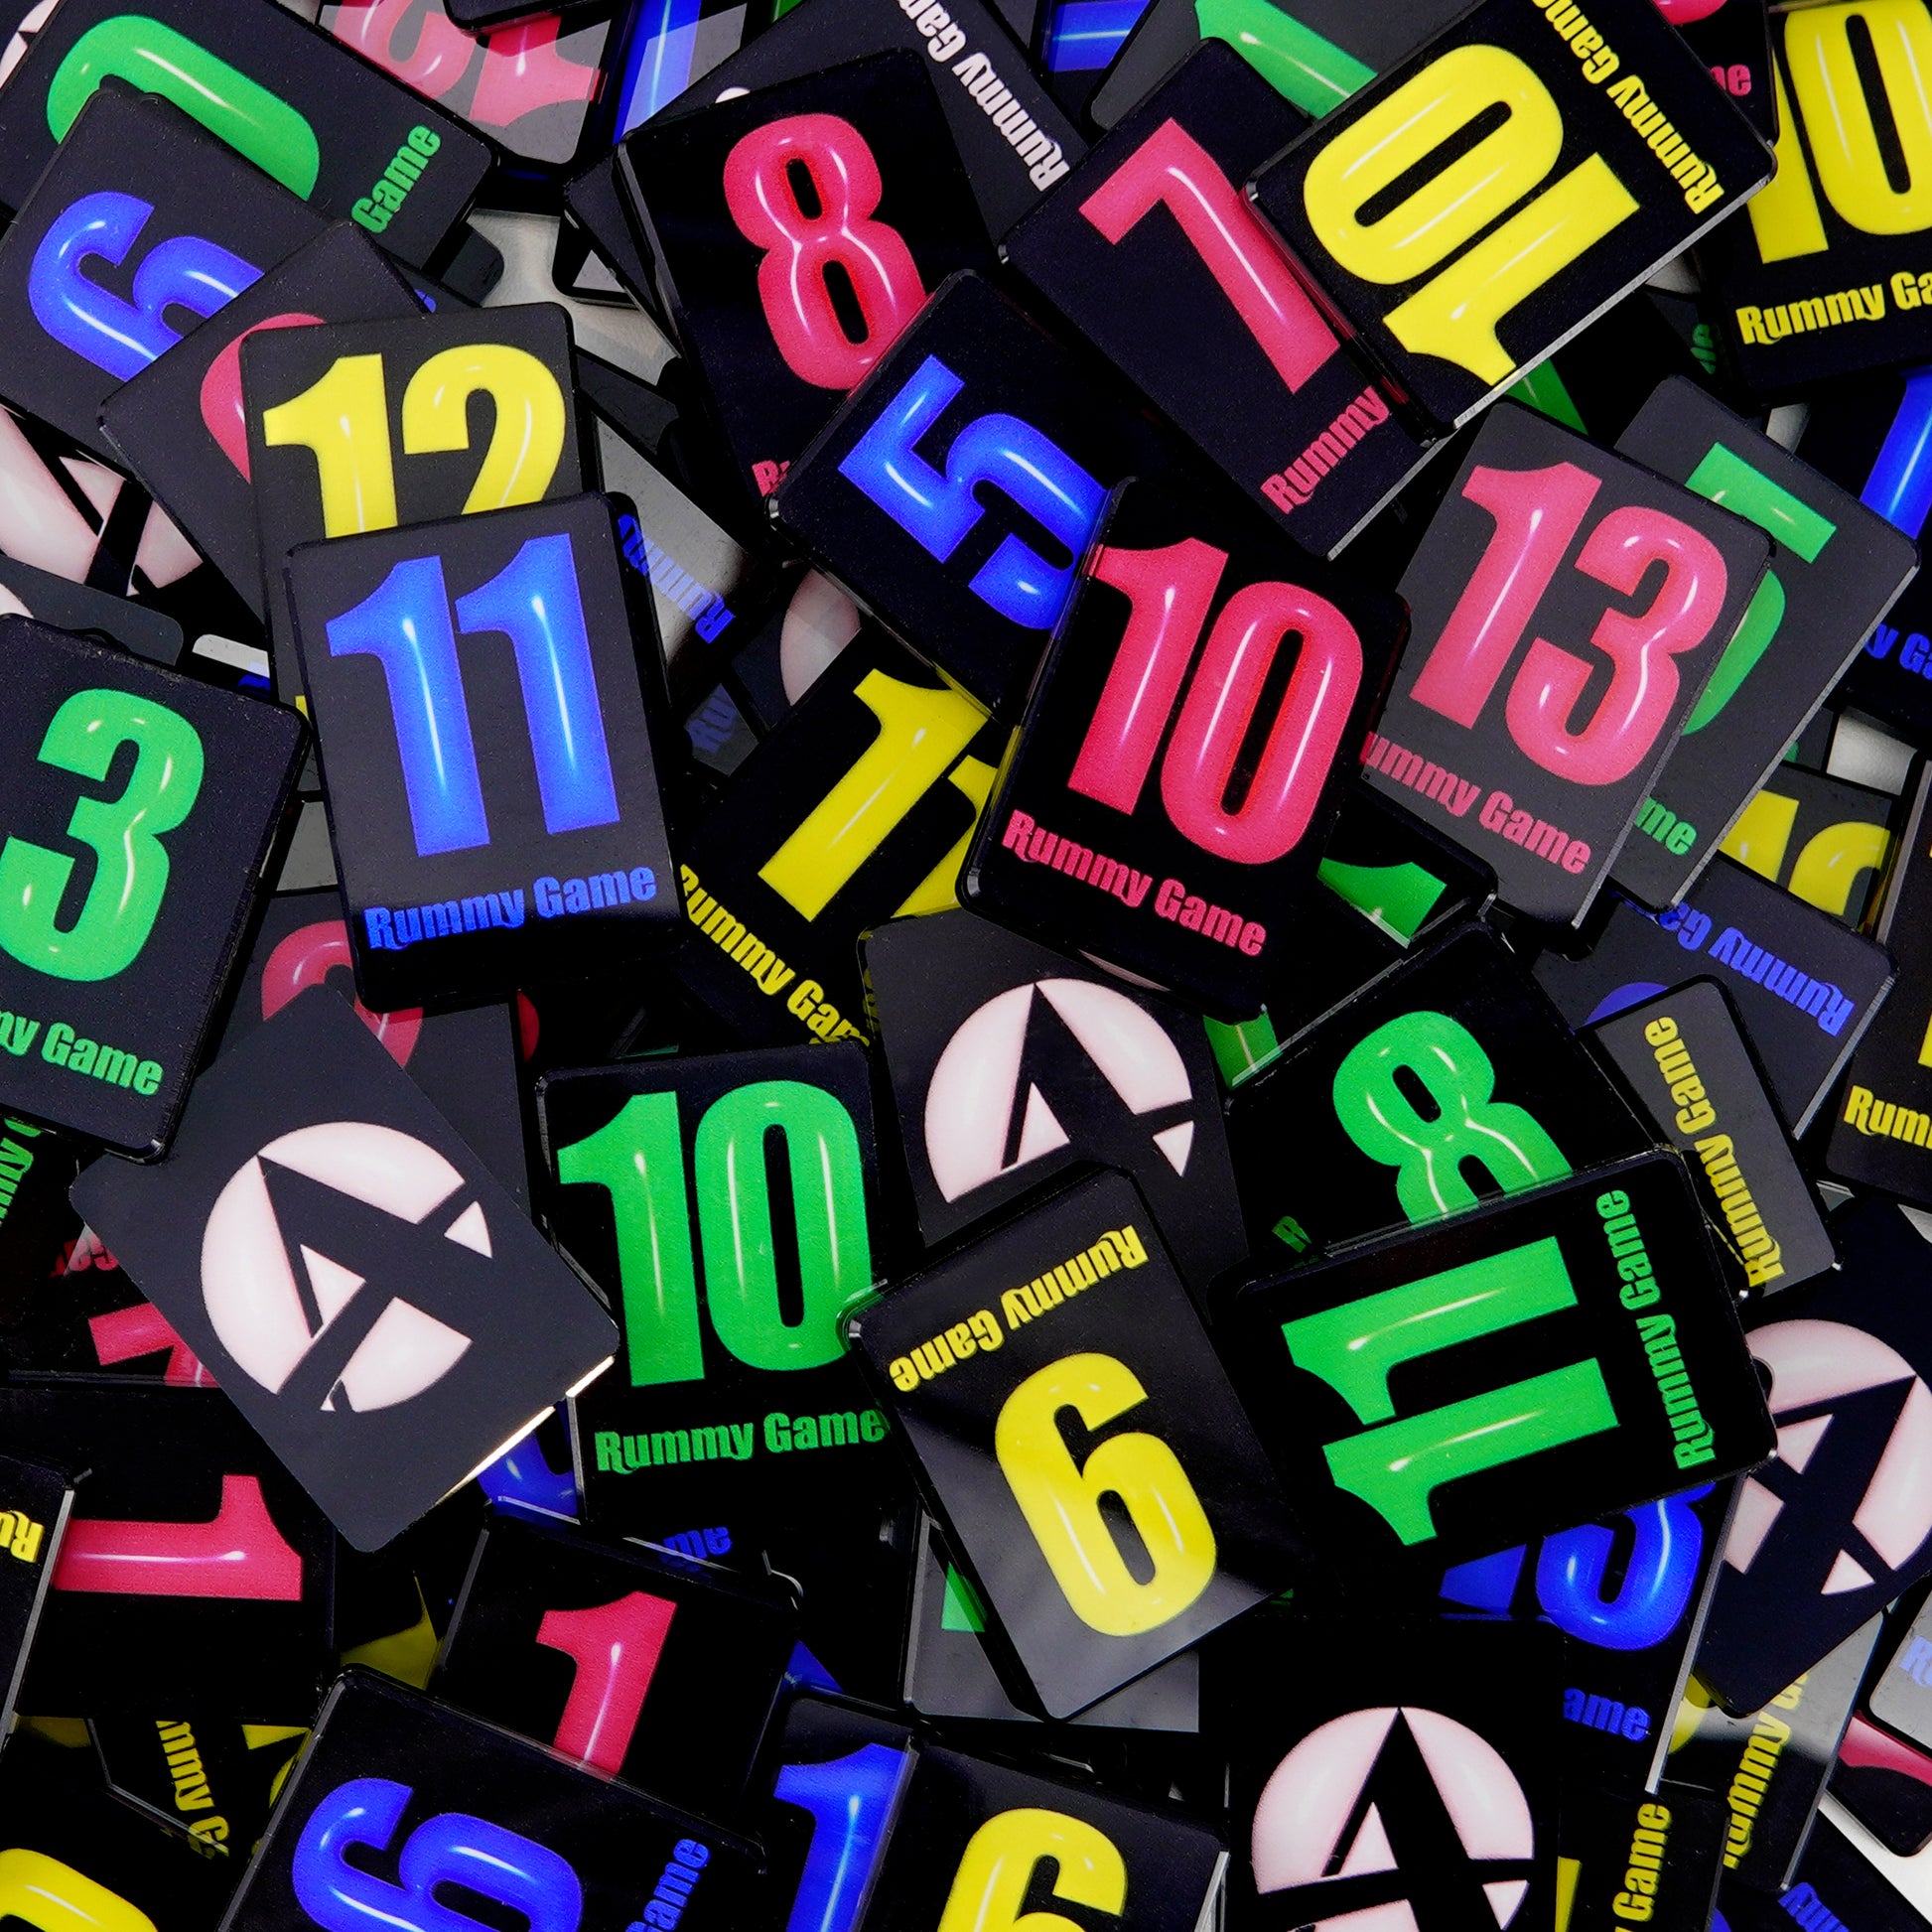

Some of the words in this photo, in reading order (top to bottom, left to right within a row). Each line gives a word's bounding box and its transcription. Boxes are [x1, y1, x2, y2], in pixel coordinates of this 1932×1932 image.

[1531, 0, 1620, 84] Gam
[350, 124, 442, 233] Game
[950, 52, 1071, 192] Rummy
[1605, 74, 1725, 214] Rummy
[723, 113, 936, 398] 8
[1078, 117, 1358, 394] 7
[1304, 45, 1640, 387] 10
[1736, 283, 1886, 345] Rummy
[837, 353, 1113, 637] 5
[1260, 385, 1390, 514] Rummy
[1410, 461, 1728, 787] 13
[324, 531, 621, 859] 11
[1067, 537, 1364, 865] 10
[1358, 731, 1480, 817] ummy
[1478, 790, 1590, 875] Game
[363, 878, 526, 951] Rummy
[532, 865, 658, 919] Game
[1001, 809, 1154, 908] Rummy
[1154, 878, 1267, 956] Game
[1707, 926, 1856, 1037] Rummy
[41, 1022, 164, 1096] Game
[1644, 1016, 1717, 1136] Game
[1844, 1084, 1932, 1152] Rum
[556, 1079, 882, 1387] 10
[1000, 1224, 1150, 1331] Rummy
[1595, 1189, 1661, 1311] Game
[1693, 1133, 1785, 1289] Rummy
[889, 1309, 1005, 1392] Game
[1280, 1235, 1620, 1547] 11
[1635, 1313, 1717, 1470] Rummy
[594, 1422, 755, 1475] Rummy
[762, 1409, 886, 1453] Game
[1723, 1711, 1791, 1869] ummy
[624, 1839, 711, 1932] ame
[1611, 1802, 1672, 1923] Game
